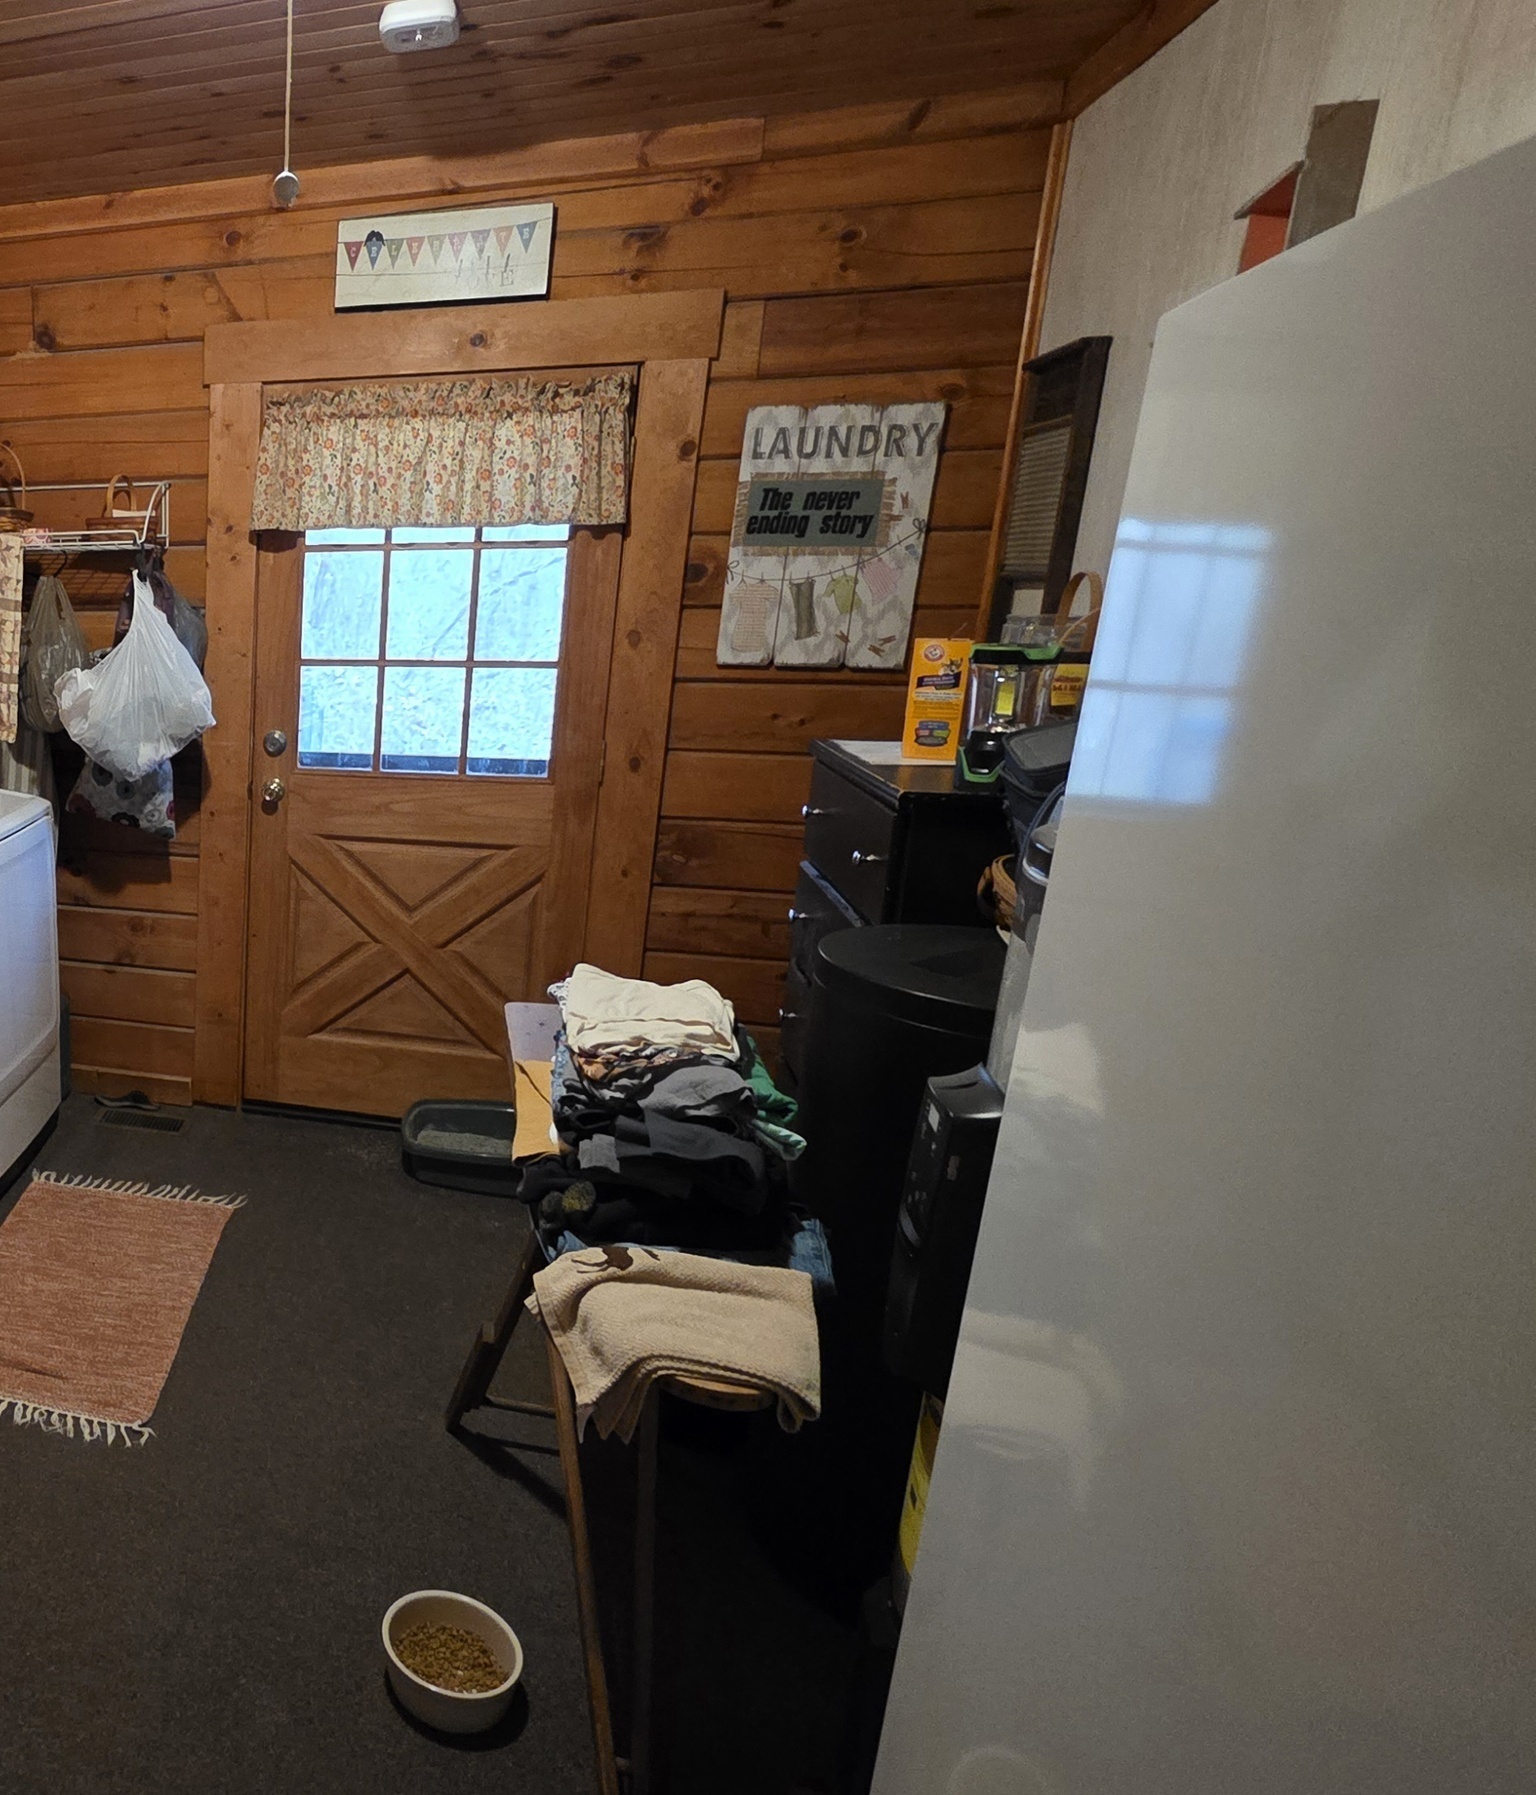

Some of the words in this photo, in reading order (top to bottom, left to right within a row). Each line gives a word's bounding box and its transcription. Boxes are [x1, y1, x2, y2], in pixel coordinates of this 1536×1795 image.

[751, 422, 939, 460] LAUNDRY
[759, 488, 794, 511] The
[802, 490, 860, 511] never
[746, 512, 810, 538] ending
[819, 512, 874, 538] story
